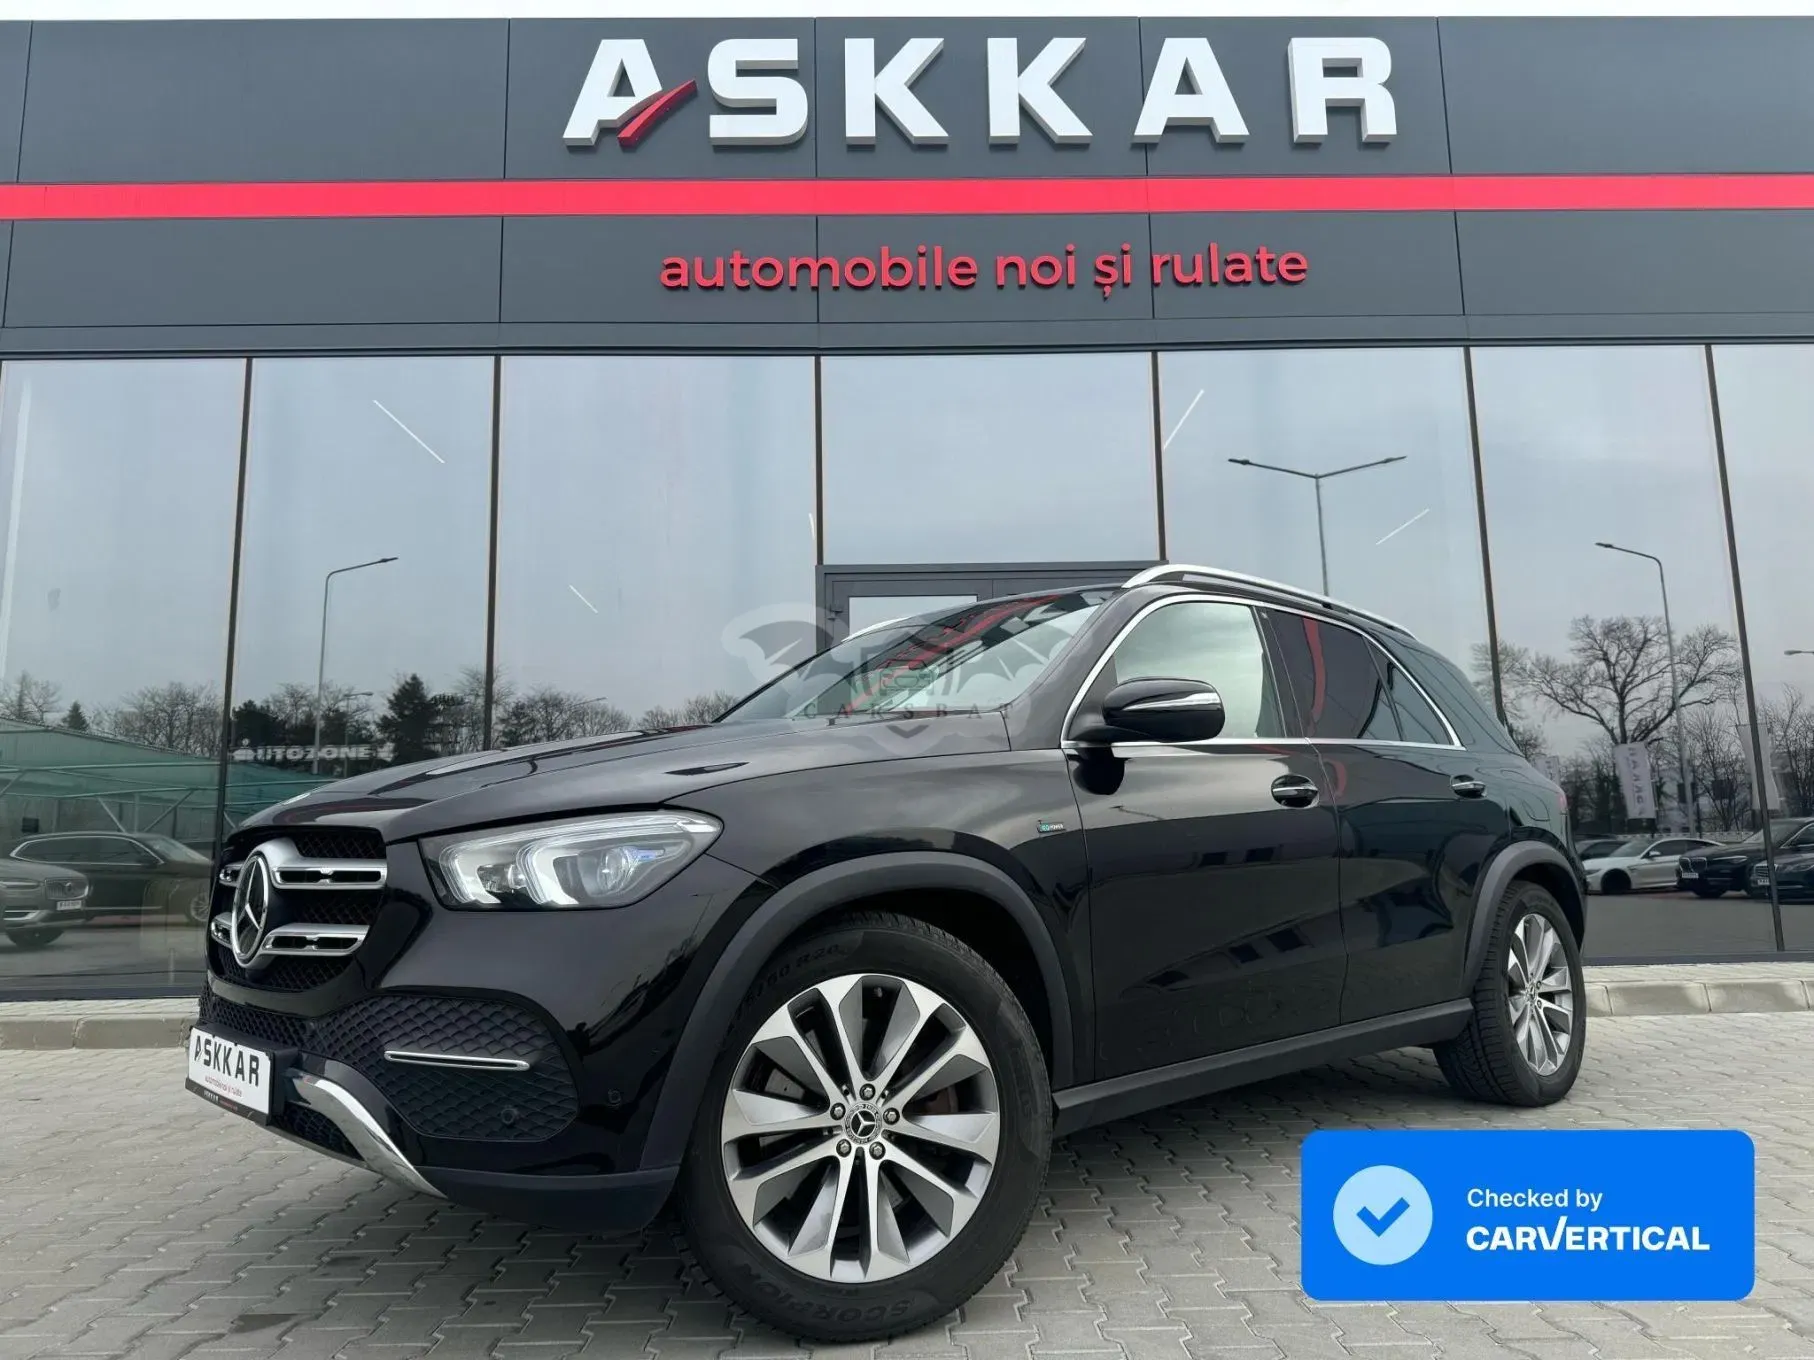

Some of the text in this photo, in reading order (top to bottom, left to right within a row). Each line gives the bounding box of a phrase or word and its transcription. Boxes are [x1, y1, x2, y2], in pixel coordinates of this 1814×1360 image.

[562, 36, 1398, 146] ASKKAR
[659, 242, 1309, 299] automobile noi și rulate
[194, 1035, 260, 1088] ASKKAR
